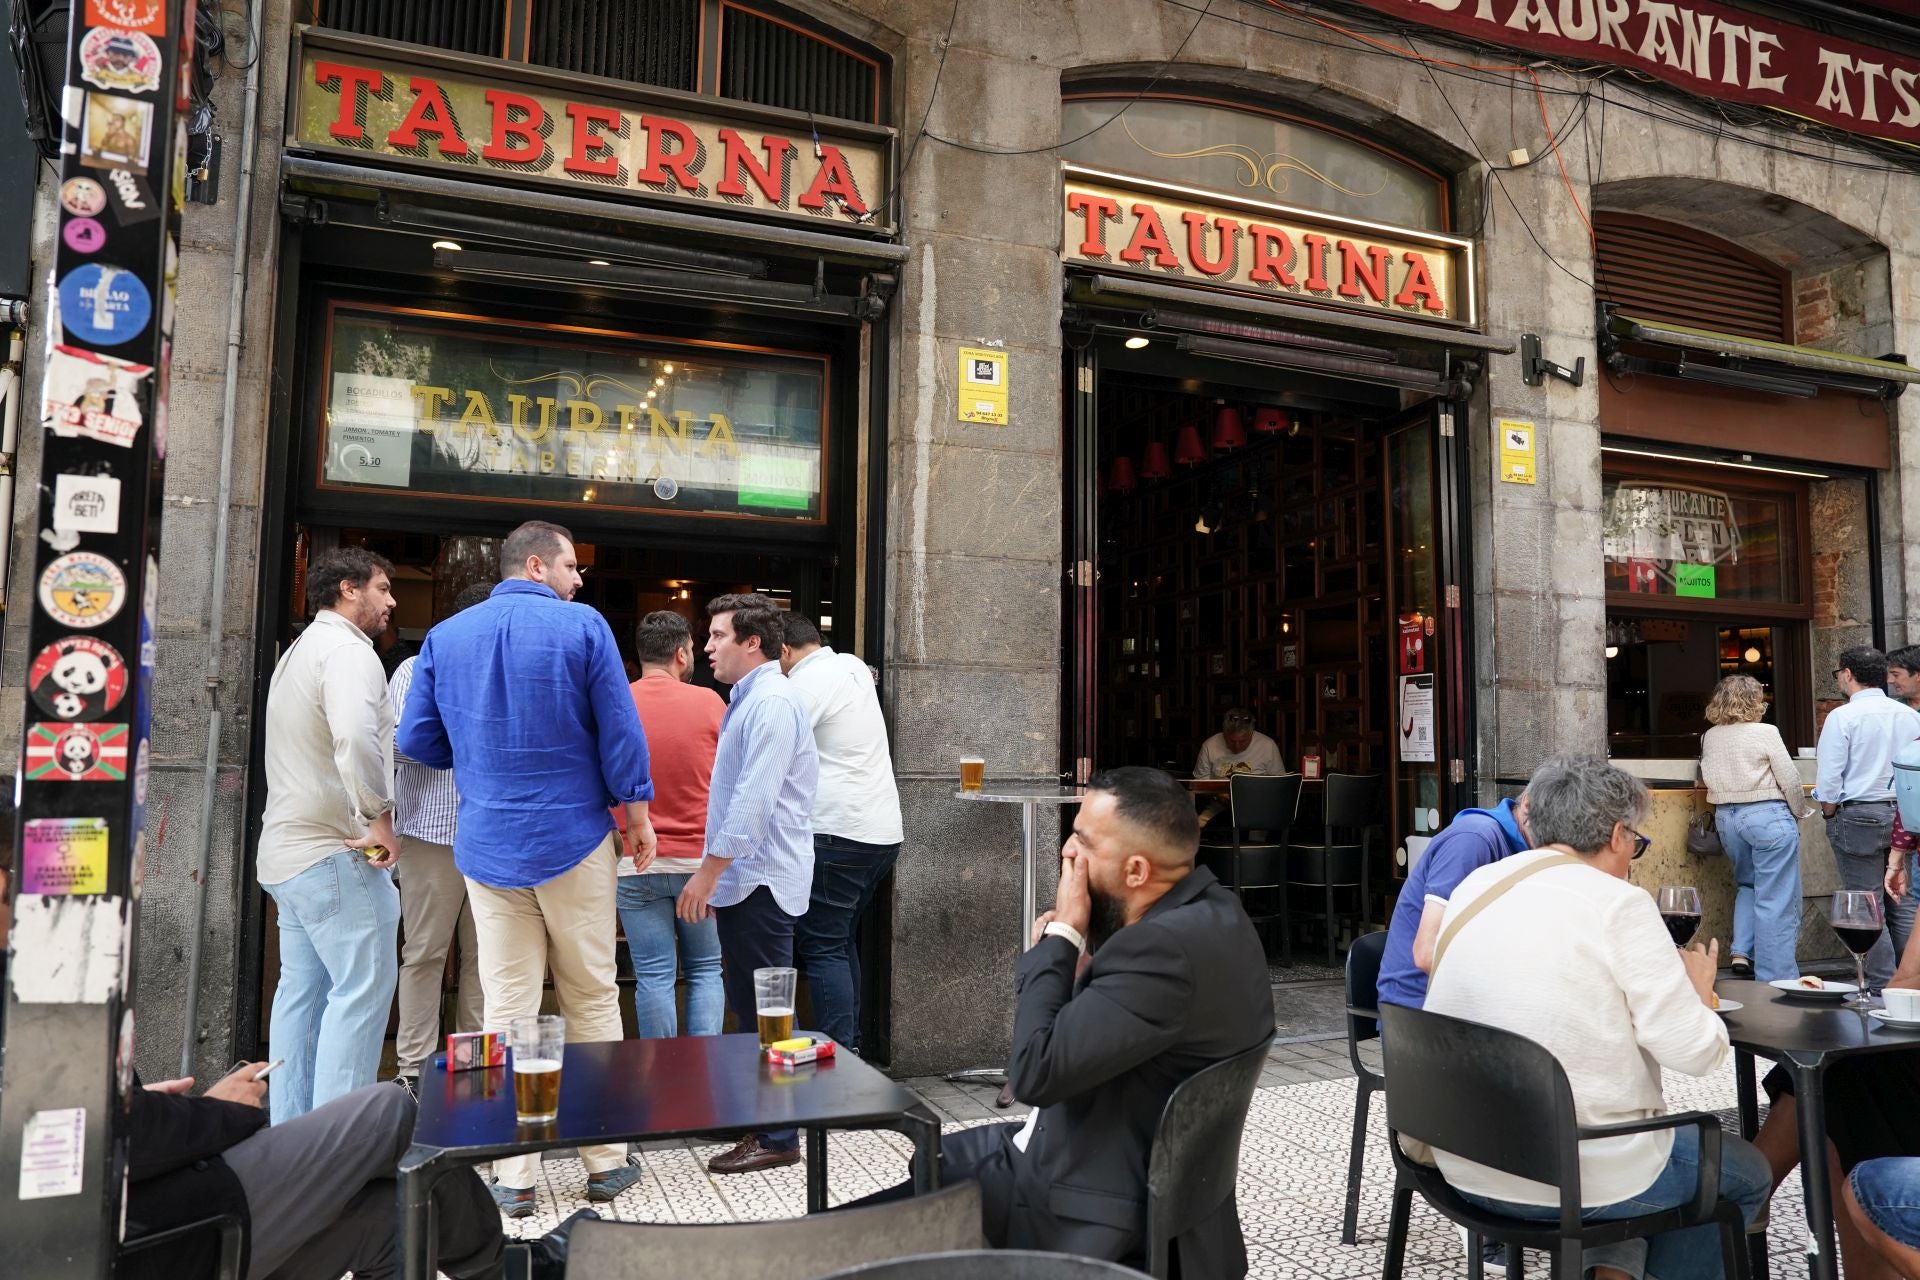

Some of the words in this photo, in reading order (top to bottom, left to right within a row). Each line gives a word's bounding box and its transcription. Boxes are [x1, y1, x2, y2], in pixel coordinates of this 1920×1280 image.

[1405, 0, 1789, 94] AURANTE
[315, 61, 870, 218] TABERNA
[1069, 191, 1446, 313] TAURINA
[346, 387, 403, 398] BOCADILLOS
[411, 387, 743, 457] TAURINA
[486, 445, 666, 483] TABERNA
[1679, 577, 1711, 587] MOJITOS
